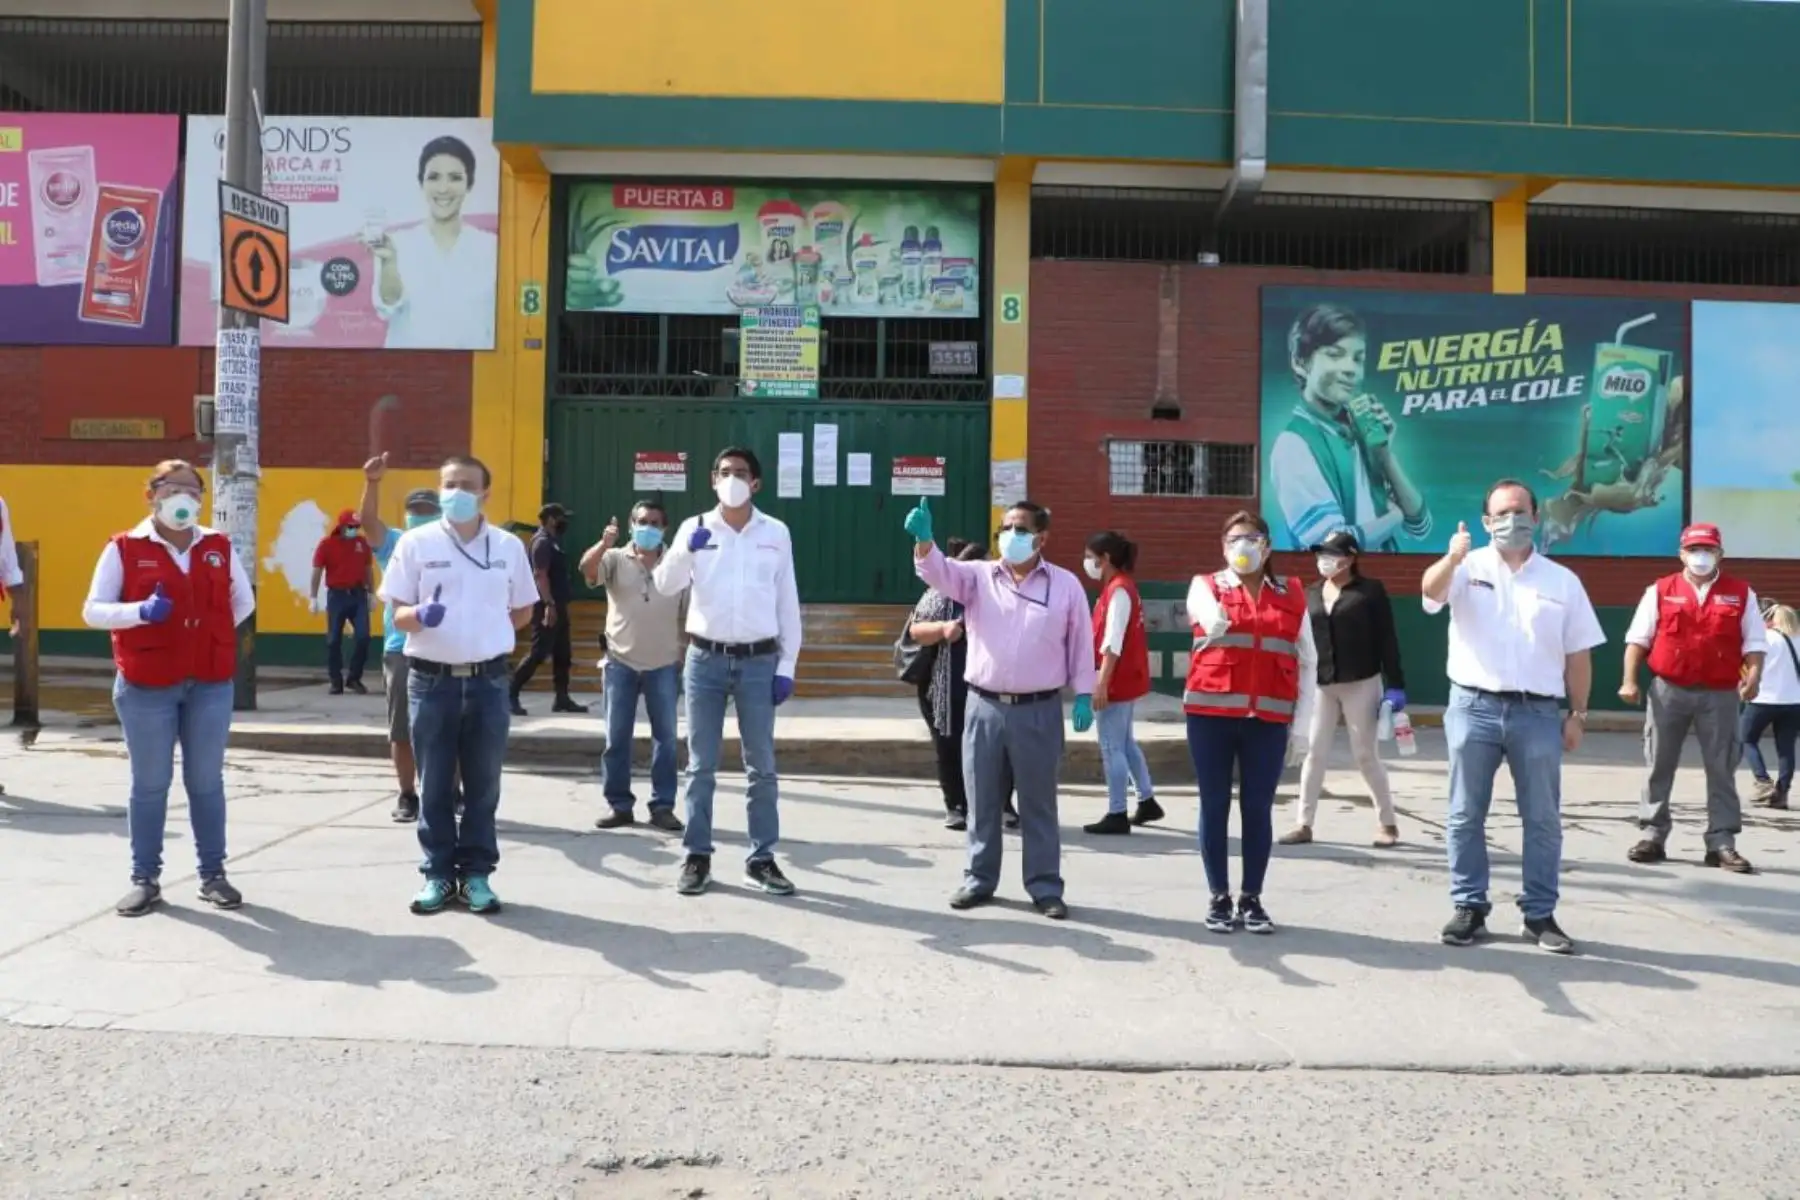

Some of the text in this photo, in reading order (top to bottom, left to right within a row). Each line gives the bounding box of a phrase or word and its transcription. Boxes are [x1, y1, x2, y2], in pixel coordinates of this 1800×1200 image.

[261, 126, 352, 154] OND'S
[263, 156, 344, 173] ARCA #1
[231, 192, 279, 226] DESVIO
[623, 187, 724, 208] PUERTA 8
[609, 228, 733, 264] SAVITAL
[325, 272, 356, 281] FILTRO
[331, 263, 350, 272] CON
[333, 281, 346, 289] UV
[524, 290, 539, 313] 8
[1003, 297, 1019, 321] 8
[1377, 318, 1565, 371] ENERGÍA
[933, 351, 973, 365] 3515
[1395, 354, 1565, 393] NUTRITIVA
[1604, 375, 1646, 394] MILO
[1401, 374, 1586, 416] PARA EL COLE
